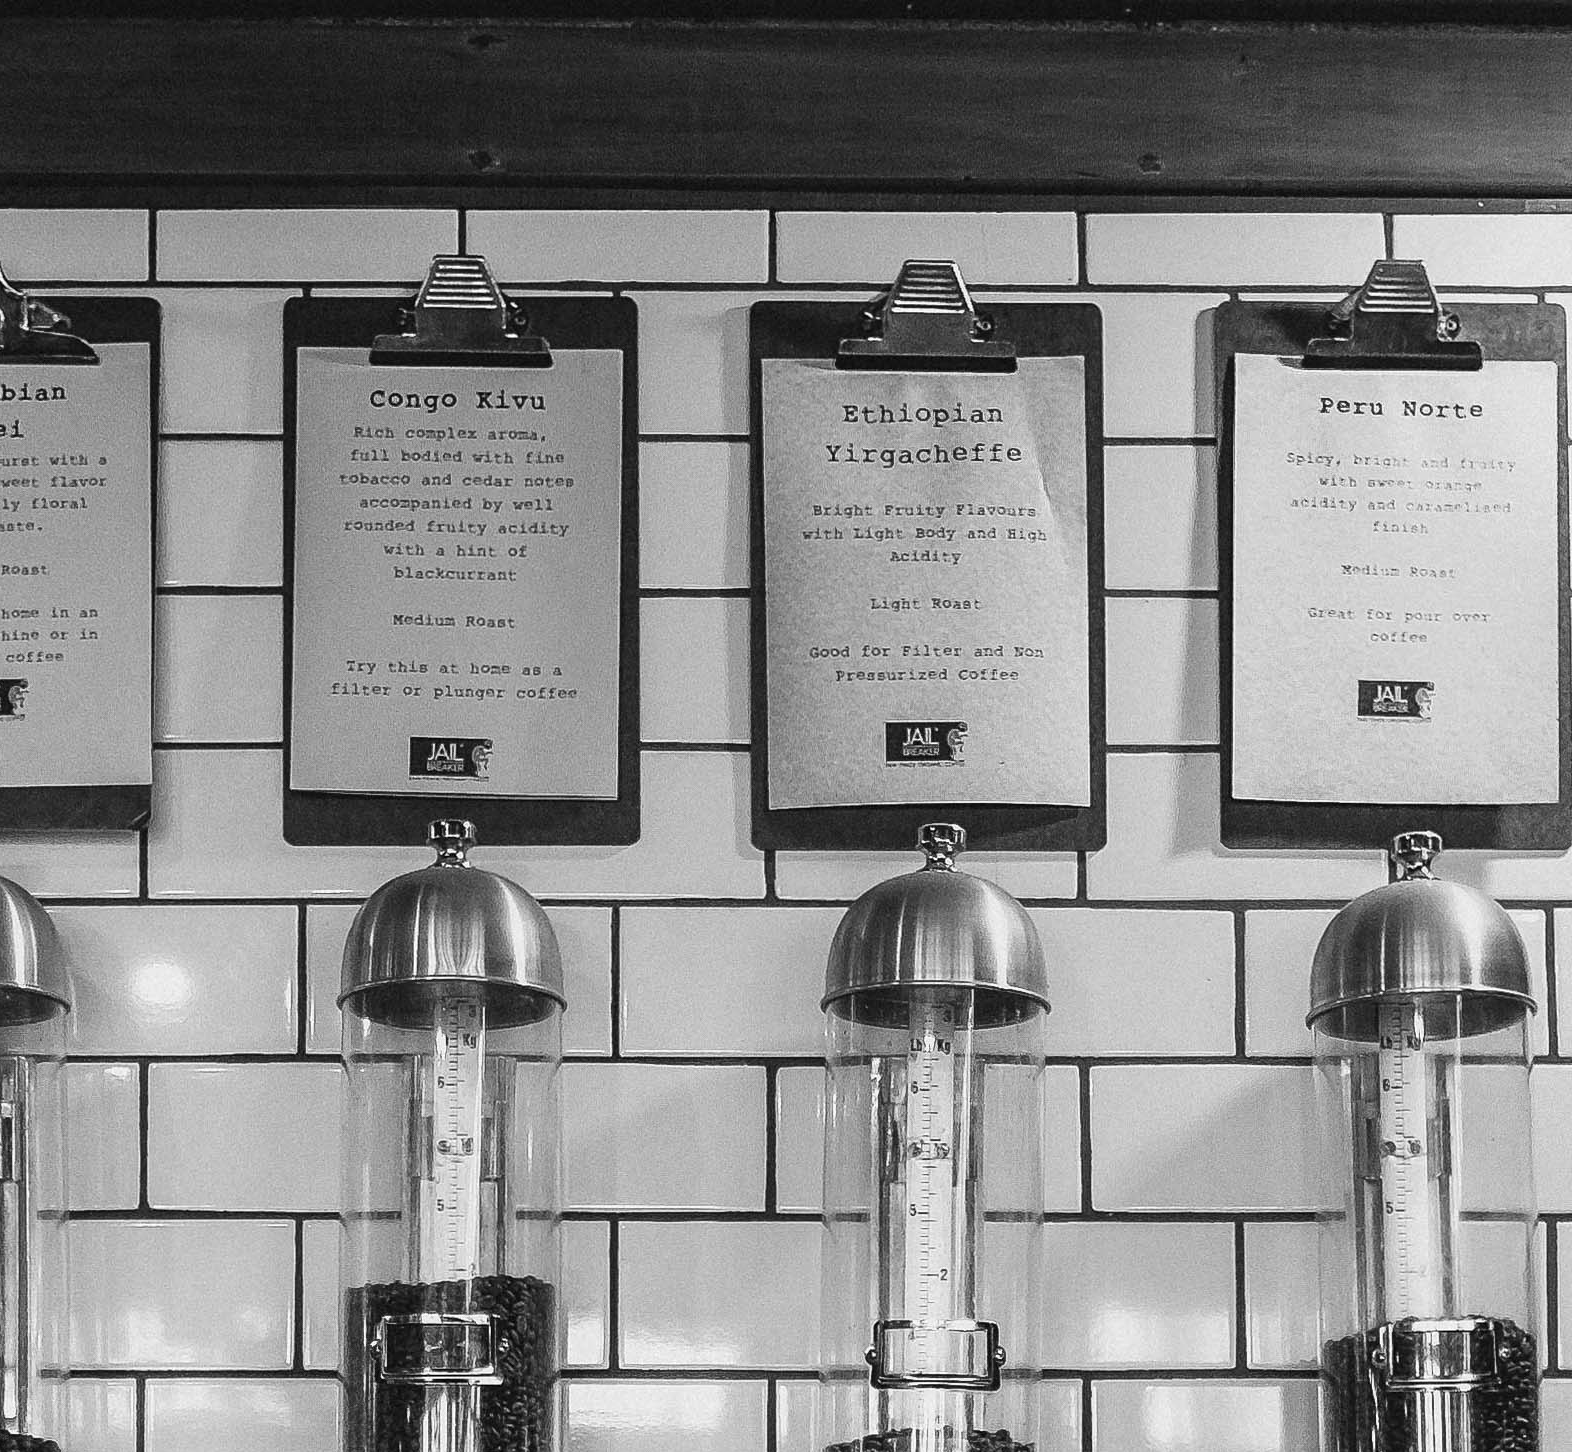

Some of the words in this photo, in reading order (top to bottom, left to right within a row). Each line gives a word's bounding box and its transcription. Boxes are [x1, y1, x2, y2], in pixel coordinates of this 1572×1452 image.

[369, 389, 458, 414] Congo
[475, 389, 546, 411] Kivu
[1319, 397, 1384, 416] Peru
[1401, 400, 1483, 420] Norte
[842, 402, 1004, 428] Ethiopian
[353, 425, 395, 439] Rich
[404, 426, 478, 442] complex
[48, 453, 89, 466] with
[350, 448, 390, 462] full
[400, 449, 463, 463] bodied
[471, 450, 514, 465] with
[525, 451, 565, 465] fine
[825, 442, 1022, 469] Yirgacheffe
[50, 475, 107, 488] flavor
[339, 472, 411, 486] tobacco
[421, 473, 452, 487] and
[461, 474, 514, 488] cedar
[524, 476, 575, 489] notes
[31, 496, 88, 510] floral
[359, 497, 473, 513] accompanied
[481, 497, 504, 514] by
[512, 498, 553, 511] well
[812, 503, 873, 519] Bright
[884, 504, 946, 519] Fruity
[956, 503, 1037, 518] Flavours
[344, 519, 416, 532] rounded
[426, 519, 488, 537] fruity
[497, 521, 570, 538] acidity
[801, 526, 844, 540] with
[852, 526, 905, 542] Light
[914, 526, 957, 542] Body
[966, 526, 997, 540] and
[1006, 528, 1048, 544] High
[383, 542, 425, 557] with
[435, 546, 445, 557] a
[456, 544, 497, 558] hint
[507, 544, 528, 558] of
[889, 549, 962, 566] Acidity
[1, 564, 47, 576] Roast
[393, 565, 517, 582] blackcurrant
[0, 608, 40, 620] home
[51, 606, 70, 619] in
[79, 608, 99, 619] an
[869, 597, 921, 613] Light
[930, 597, 981, 610] Roast
[392, 613, 456, 627] Medium
[465, 615, 516, 629] Roast
[49, 630, 69, 641] or
[79, 627, 99, 641] in
[5, 650, 64, 663] coffee
[809, 645, 851, 659] Good
[861, 644, 891, 658] for
[901, 644, 962, 658] Filter
[973, 644, 1004, 658] and
[1013, 646, 1045, 659] Non
[345, 659, 377, 676] Try
[387, 660, 429, 674] this
[438, 663, 460, 675] at
[469, 662, 512, 675] home
[521, 665, 542, 677] as
[552, 666, 563, 677] a
[835, 668, 948, 682] Pressurized
[957, 668, 1019, 681] Coffee
[331, 682, 392, 697] filter
[402, 685, 422, 697] or
[433, 684, 506, 701] plunger
[516, 686, 578, 700] coffee
[903, 728, 939, 745] JAIL
[428, 744, 466, 761] JAIL
[911, 1083, 918, 1094] 6
[1386, 1202, 1393, 1213] 5
[940, 1269, 948, 1281] 2
